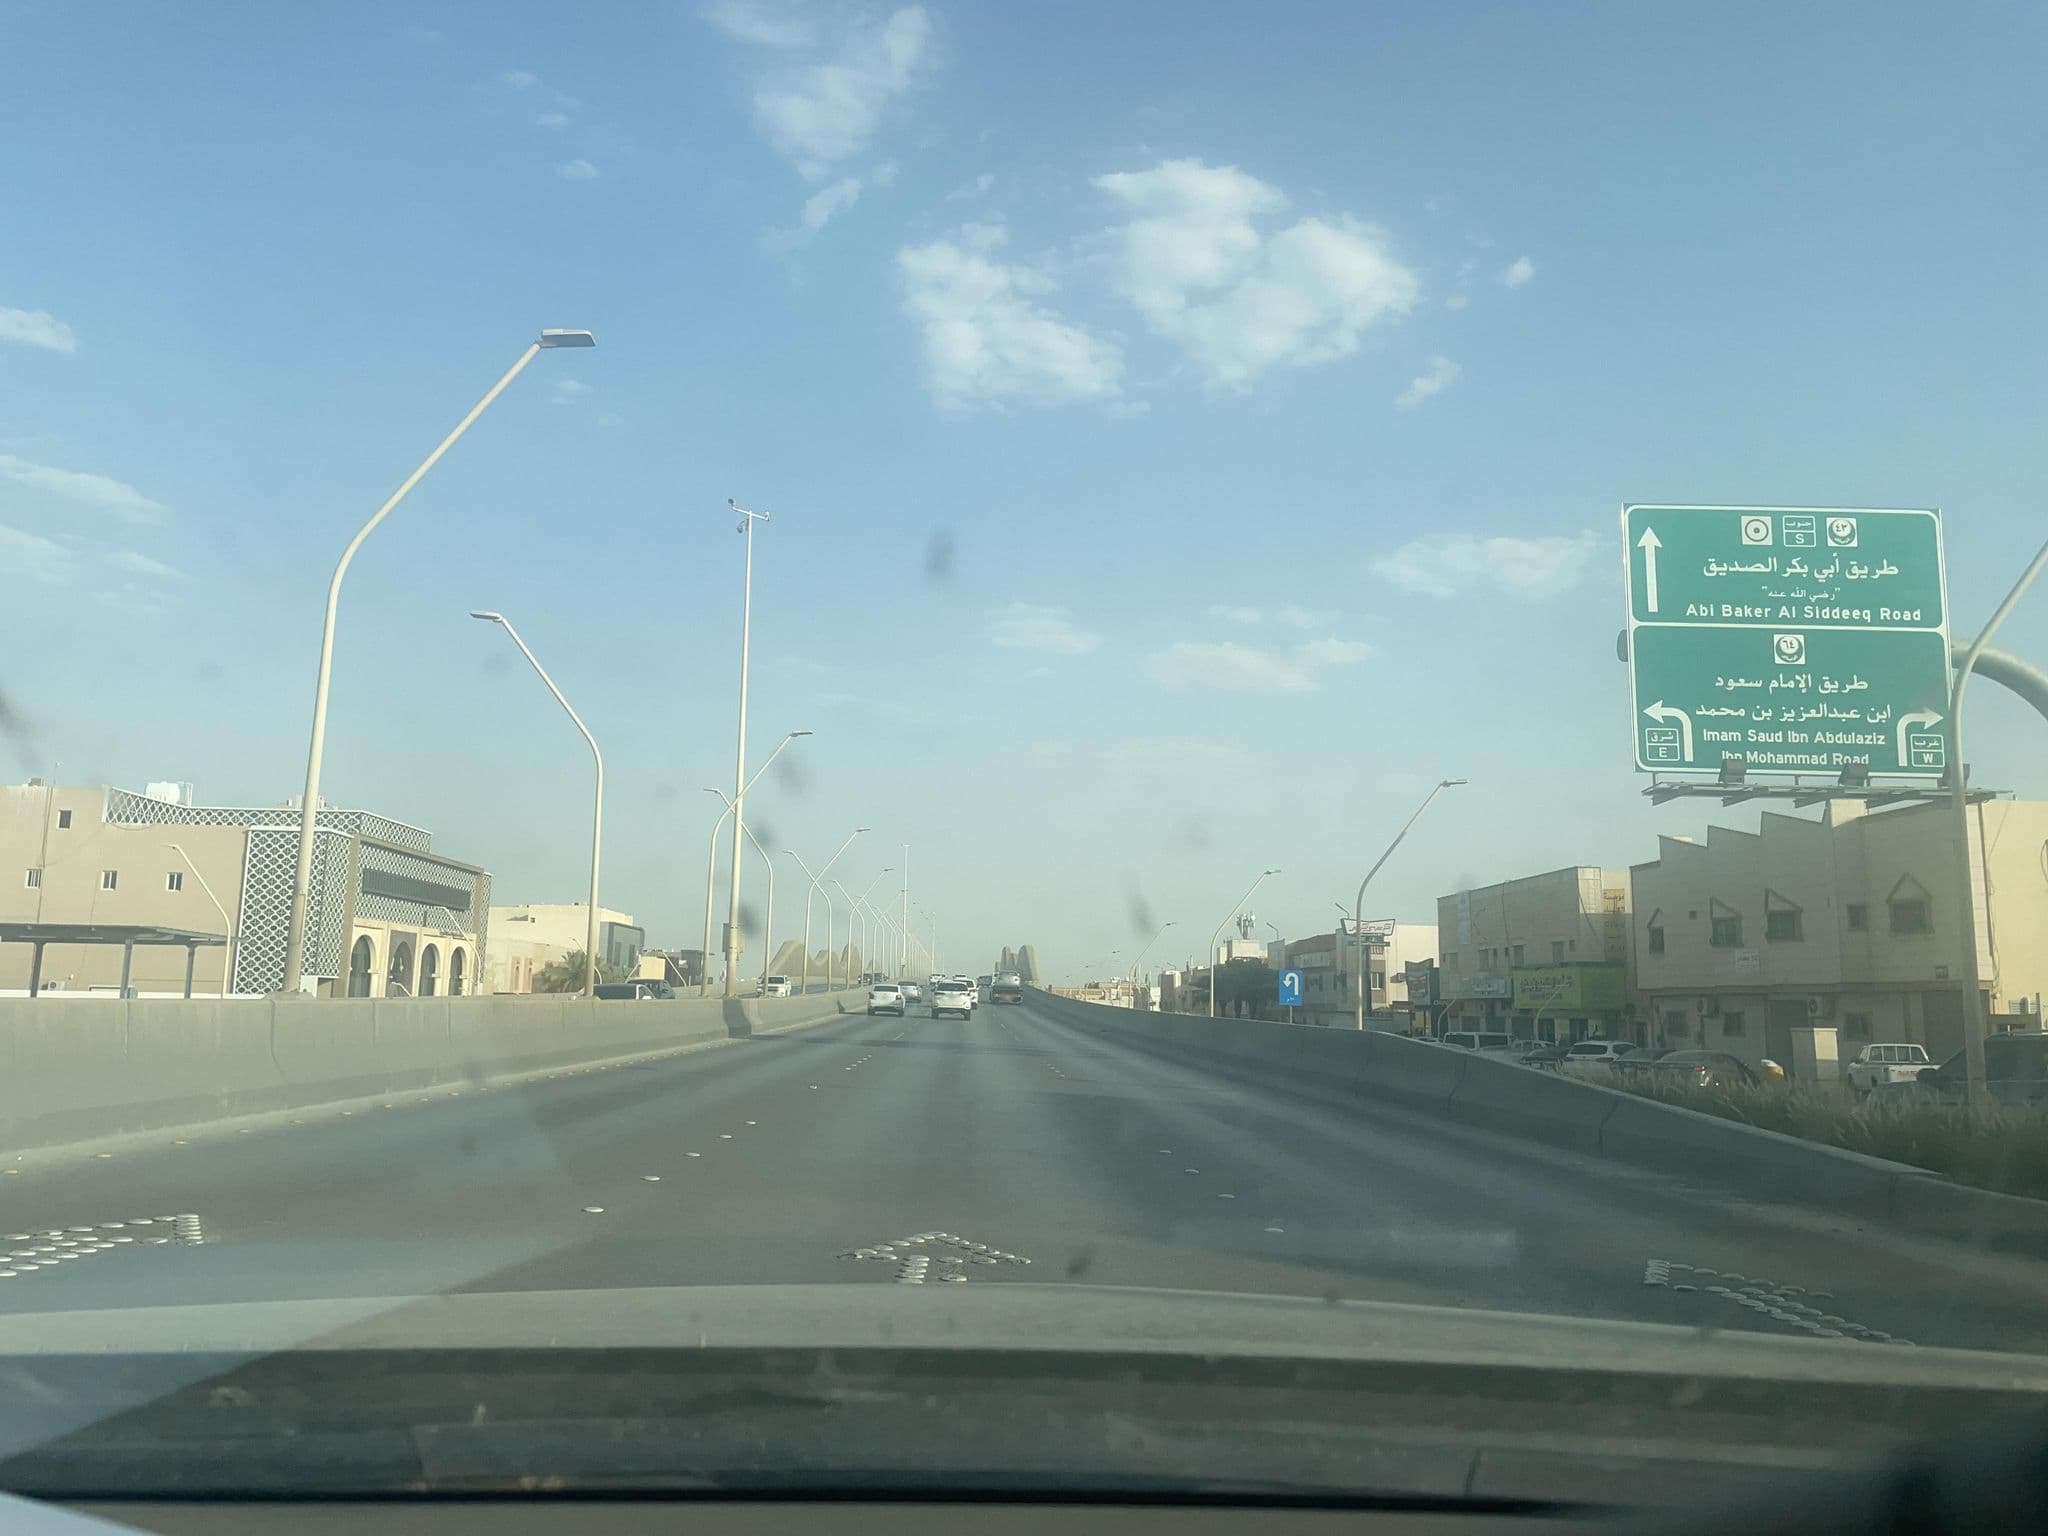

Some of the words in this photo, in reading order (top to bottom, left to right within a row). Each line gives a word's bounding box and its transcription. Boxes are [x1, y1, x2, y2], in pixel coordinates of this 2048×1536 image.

[1785, 520, 1812, 529] جنوب
[1796, 534, 1804, 544] S
[1704, 557, 1777, 576] الصديق
[1782, 557, 1809, 578] بكر
[1815, 553, 1839, 582] أبي
[1846, 559, 1898, 579] طريق
[1686, 604, 1713, 616] Abi
[1722, 605, 1771, 617] Baker
[1779, 606, 1795, 618] Al
[1804, 606, 1870, 622] Siddeeq
[1880, 608, 1920, 620] Road
[1782, 640, 1796, 651] ٦٤
[1715, 676, 1763, 690] سعود
[1769, 674, 1811, 694] الإمام
[1819, 675, 1868, 693] طريق
[1695, 704, 1746, 717] محمد
[1752, 708, 1773, 722] بن
[1779, 703, 1860, 722] عبدالعزيز
[1867, 704, 1890, 722] ابن
[1650, 731, 1674, 742] شرق
[1704, 729, 1741, 741] Imam
[1748, 729, 1782, 742] Saud
[1788, 731, 1808, 742] Ibn
[1814, 732, 1885, 744] Abdulaziz
[1914, 739, 1940, 749] غرب
[1659, 747, 1667, 757] E
[1747, 751, 1827, 764] Mohammad
[1833, 753, 1868, 765] Road
[1923, 753, 1933, 763] W
